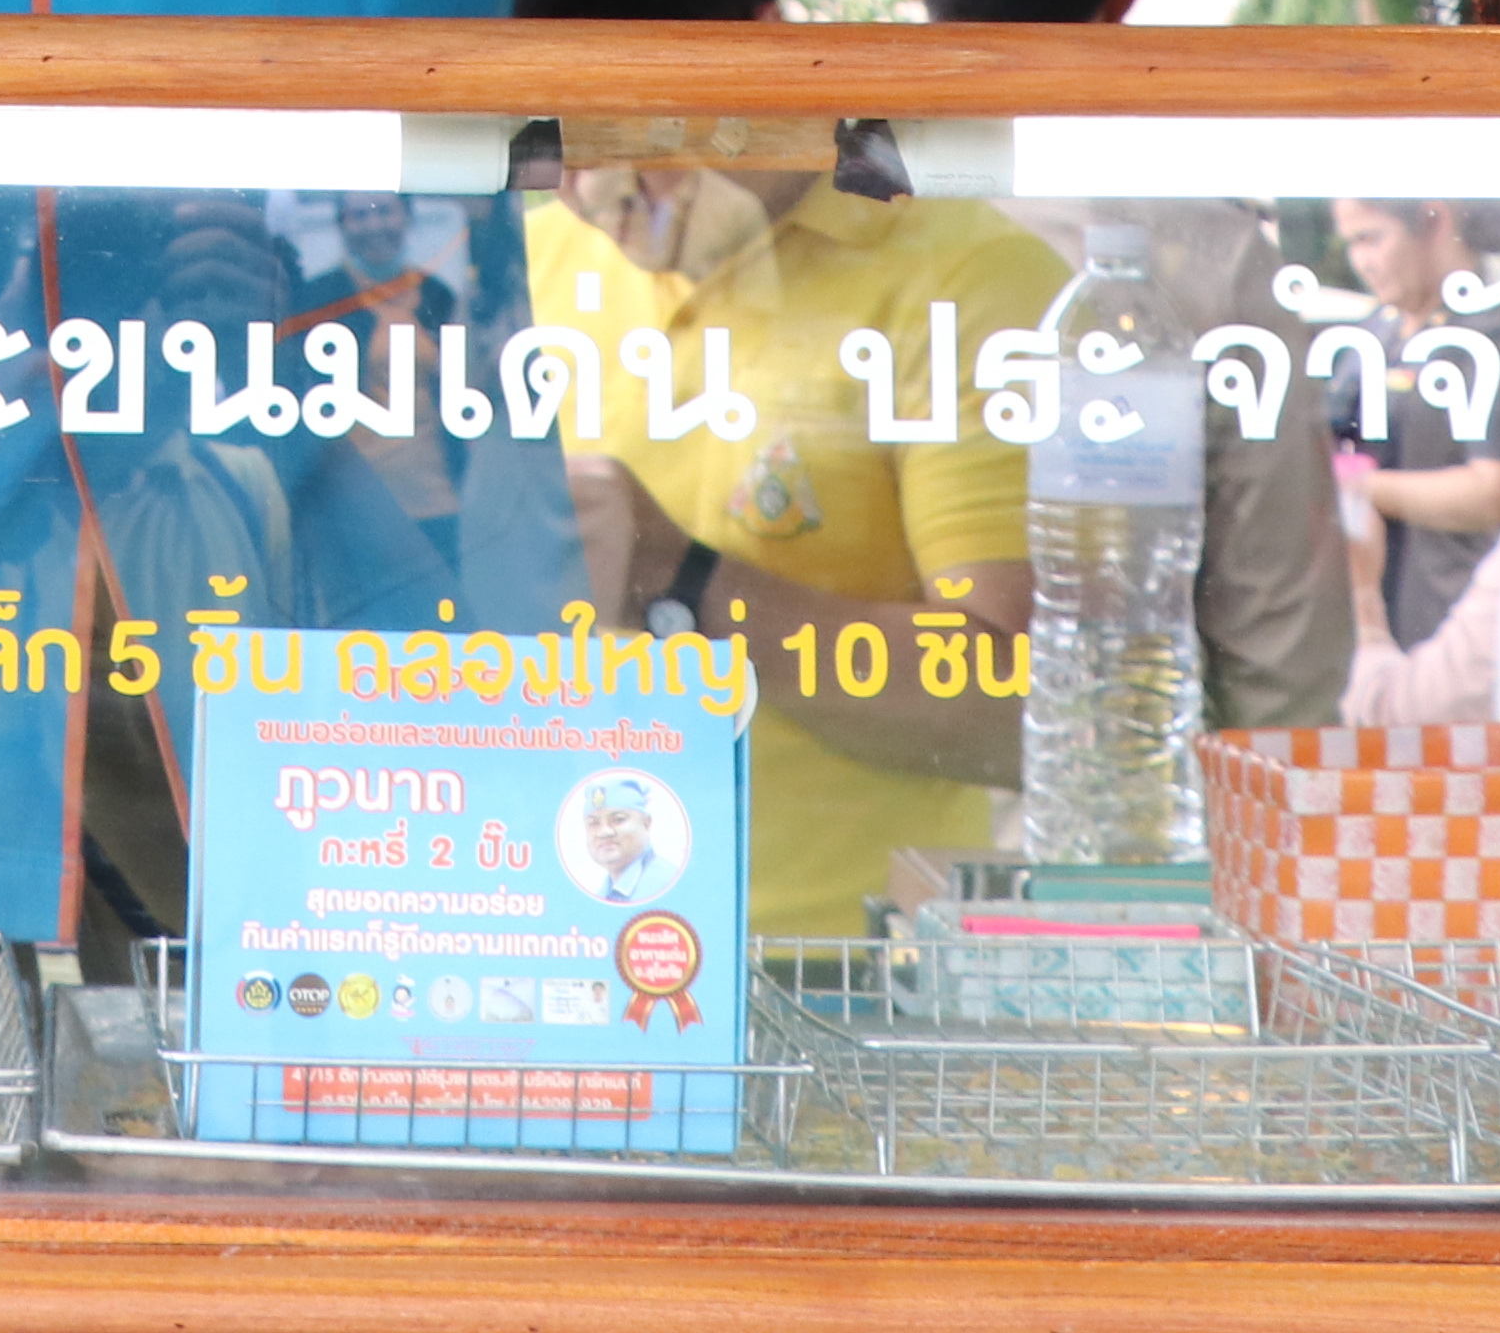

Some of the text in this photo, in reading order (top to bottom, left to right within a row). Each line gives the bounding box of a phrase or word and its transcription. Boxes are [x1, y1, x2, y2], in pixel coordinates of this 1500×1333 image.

[108, 619, 161, 695] 5
[187, 576, 302, 694] ชิ้น
[336, 598, 750, 716] กล่องใหญ่
[780, 621, 889, 698] 10
[911, 576, 1032, 698] ชิ้น
[273, 764, 466, 831] ภูวนาถ
[319, 819, 533, 871] กะหรี่ 2 ปั๊บ
[305, 883, 546, 921] สุดยอดความอร่อย
